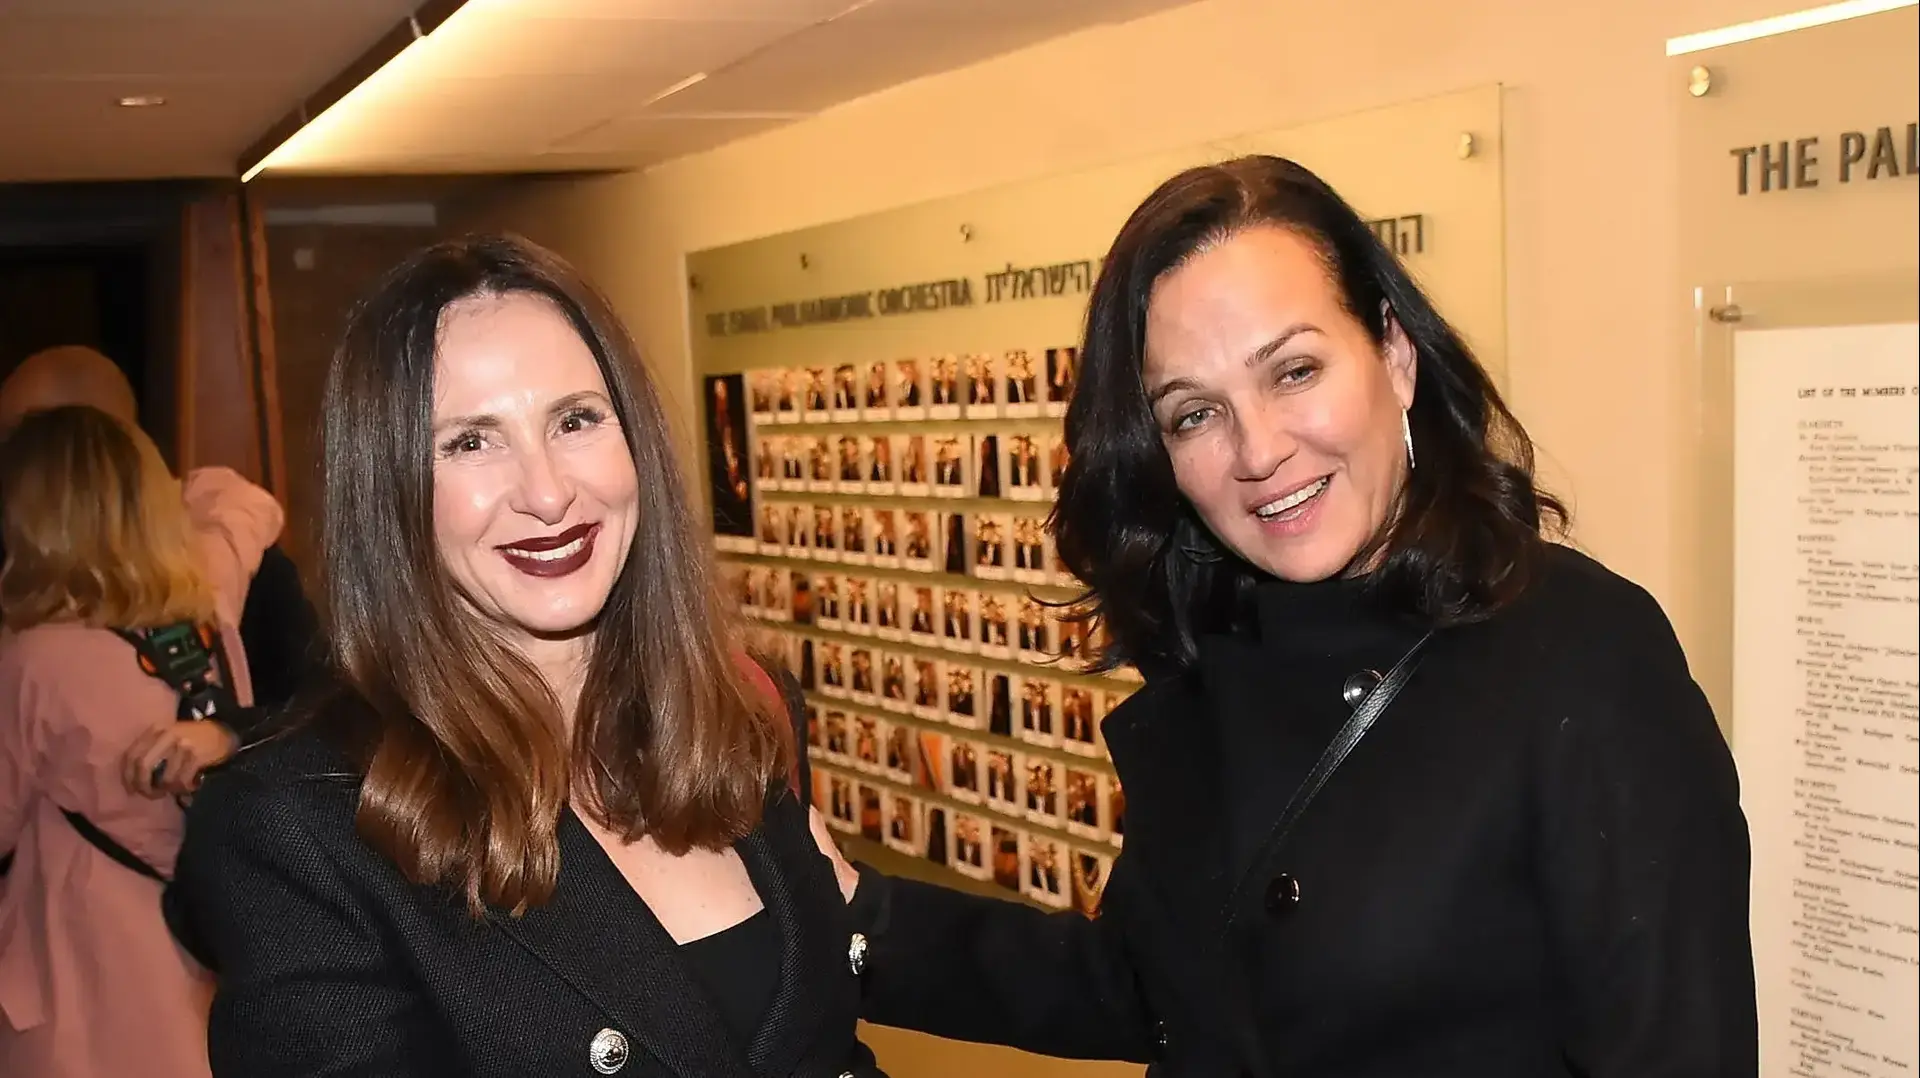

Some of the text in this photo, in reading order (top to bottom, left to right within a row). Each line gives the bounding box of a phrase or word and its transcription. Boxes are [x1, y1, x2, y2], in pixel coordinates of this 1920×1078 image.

[1728, 137, 1819, 195] THE
[877, 278, 973, 316] ORCHESTRA
[985, 262, 1091, 303] הישראלית
